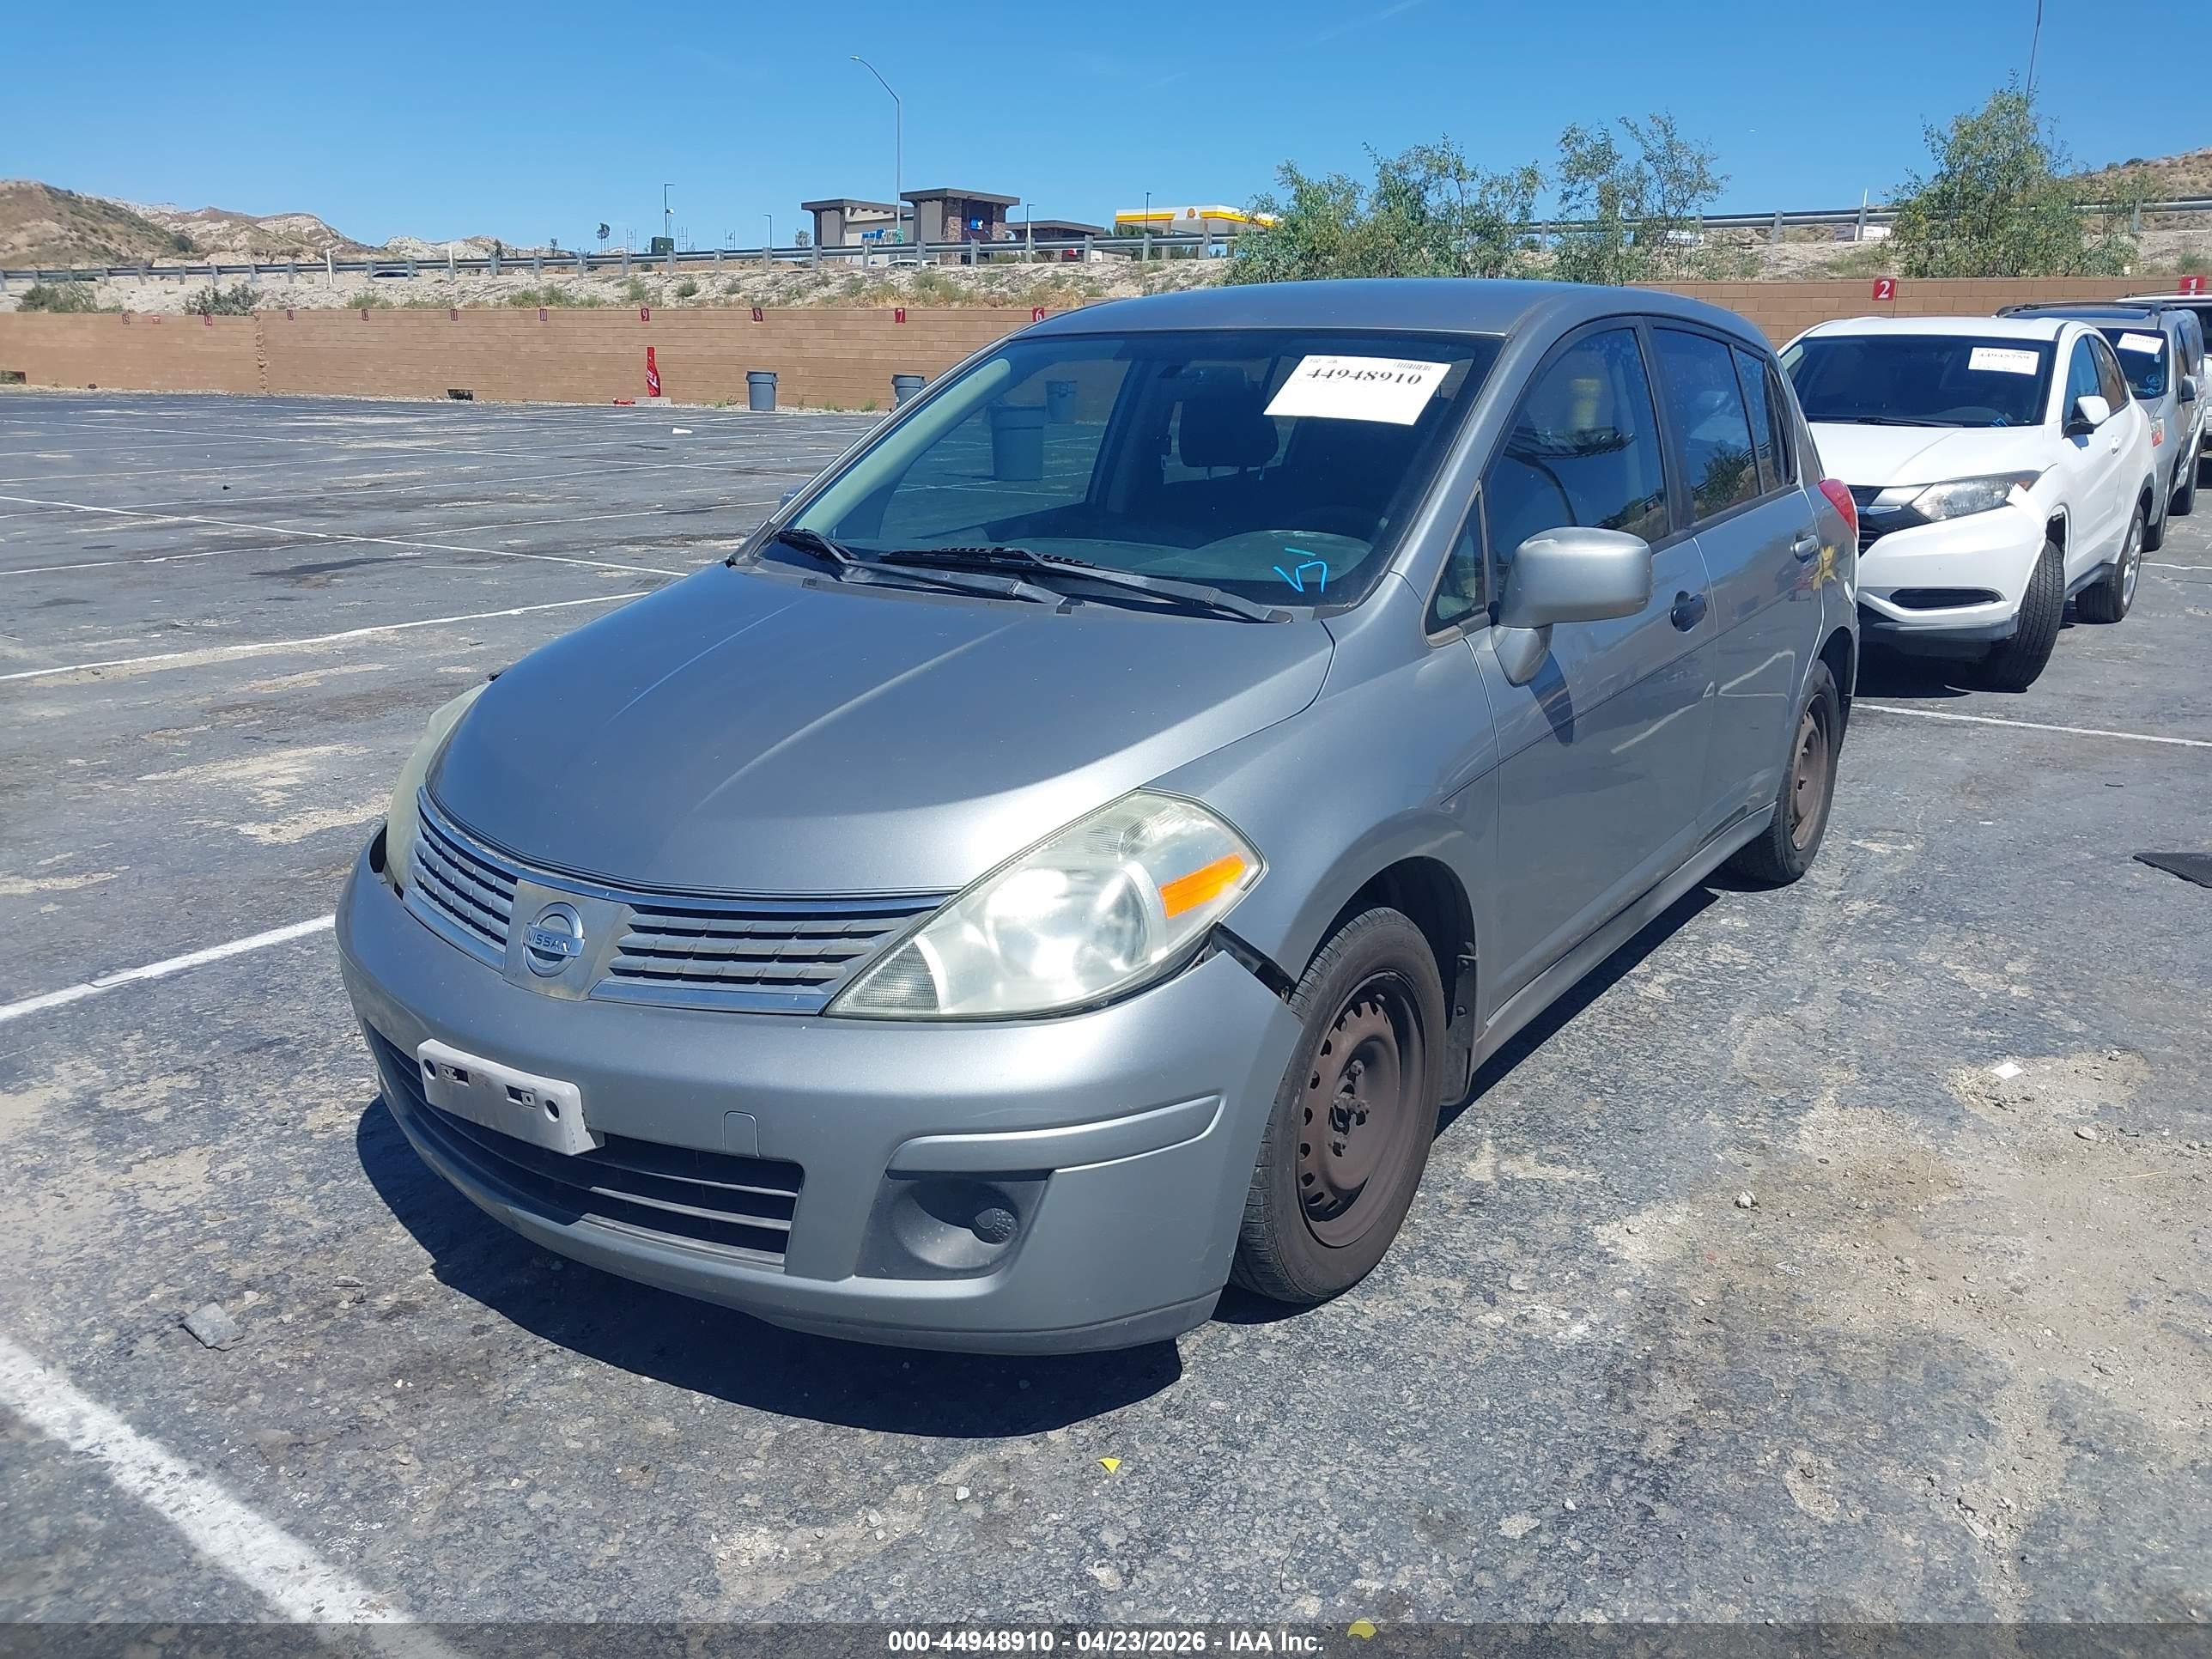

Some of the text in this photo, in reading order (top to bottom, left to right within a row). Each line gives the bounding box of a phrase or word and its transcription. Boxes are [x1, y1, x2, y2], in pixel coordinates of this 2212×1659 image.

[1877, 280, 1891, 299] 2
[2188, 278, 2197, 295] 1
[1036, 309, 1042, 322] 6
[1306, 368, 1422, 386] 44948910
[526, 929, 572, 952] NISSAN
